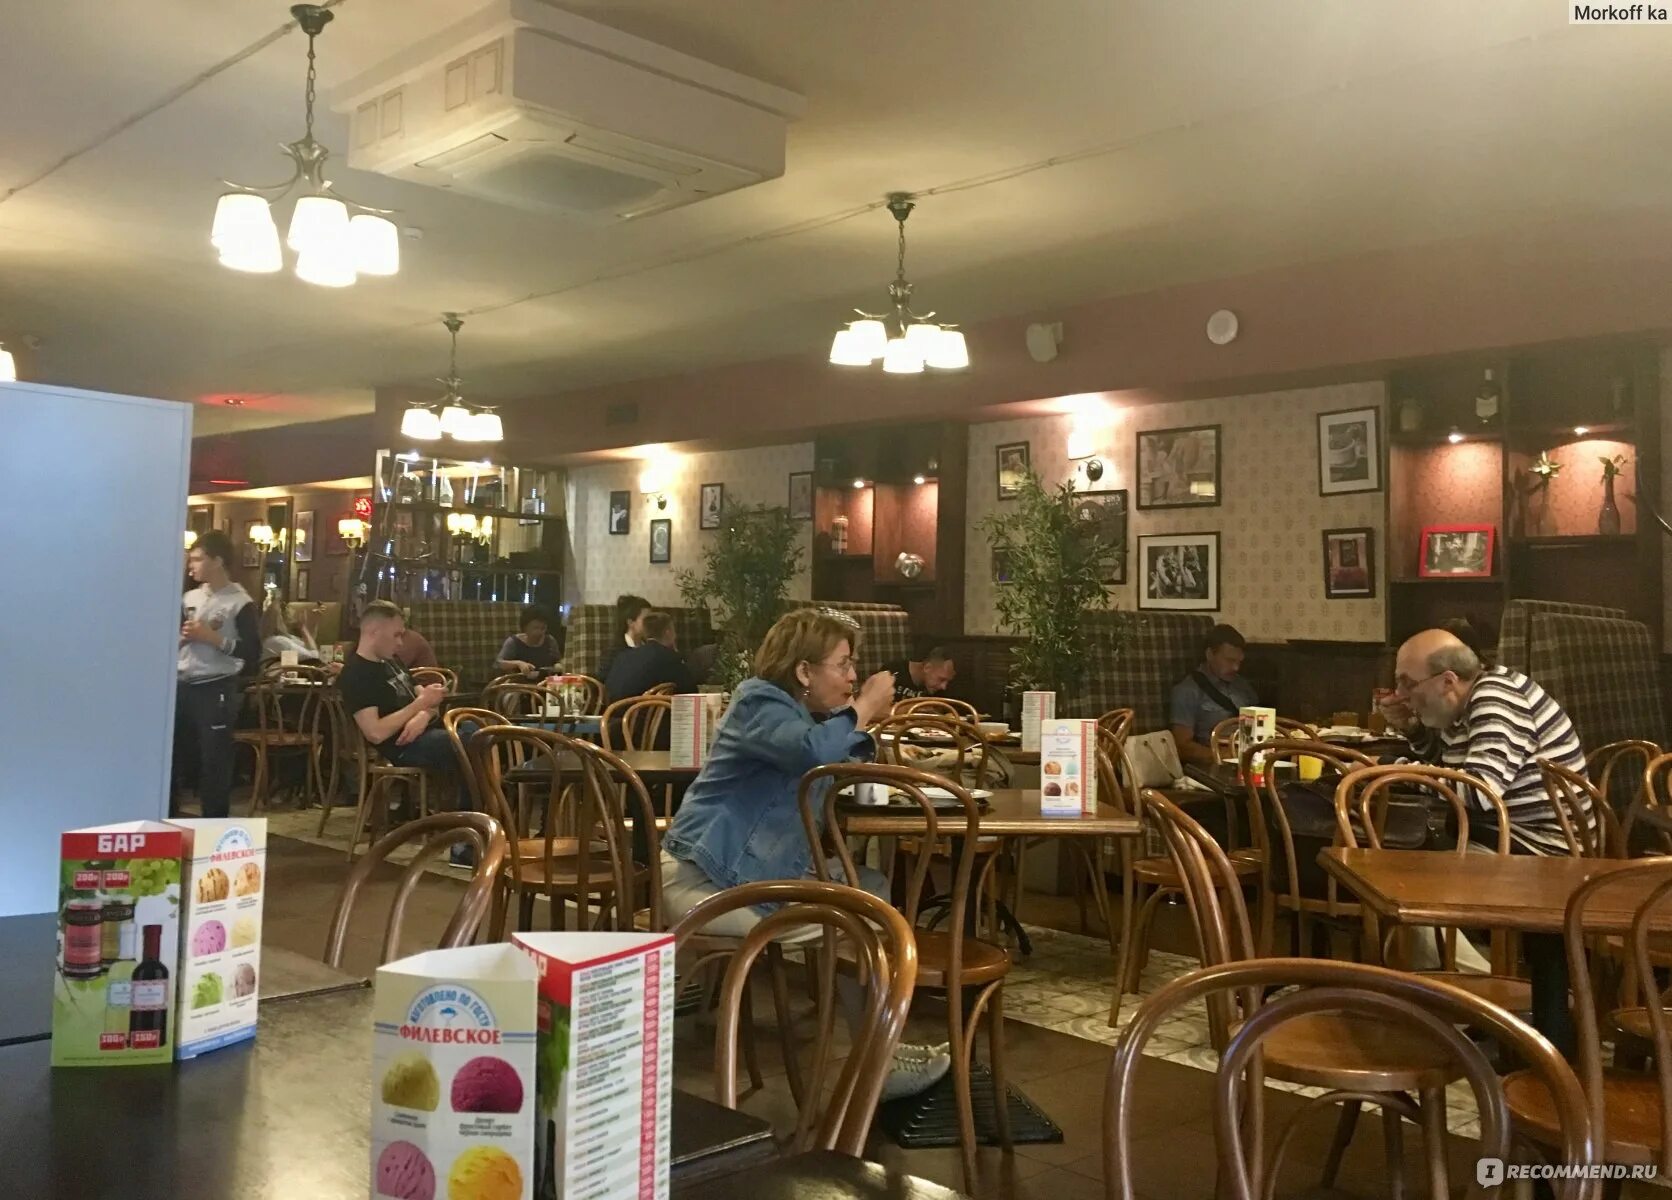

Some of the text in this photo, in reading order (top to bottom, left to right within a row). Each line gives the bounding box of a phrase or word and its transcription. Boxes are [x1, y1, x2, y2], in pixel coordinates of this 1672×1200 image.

[97, 833, 146, 853] БАР
[409, 989, 457, 1023] ИЗГОТОВЛЕНО
[399, 1024, 501, 1045] ФИЛЕВСКОЕ
